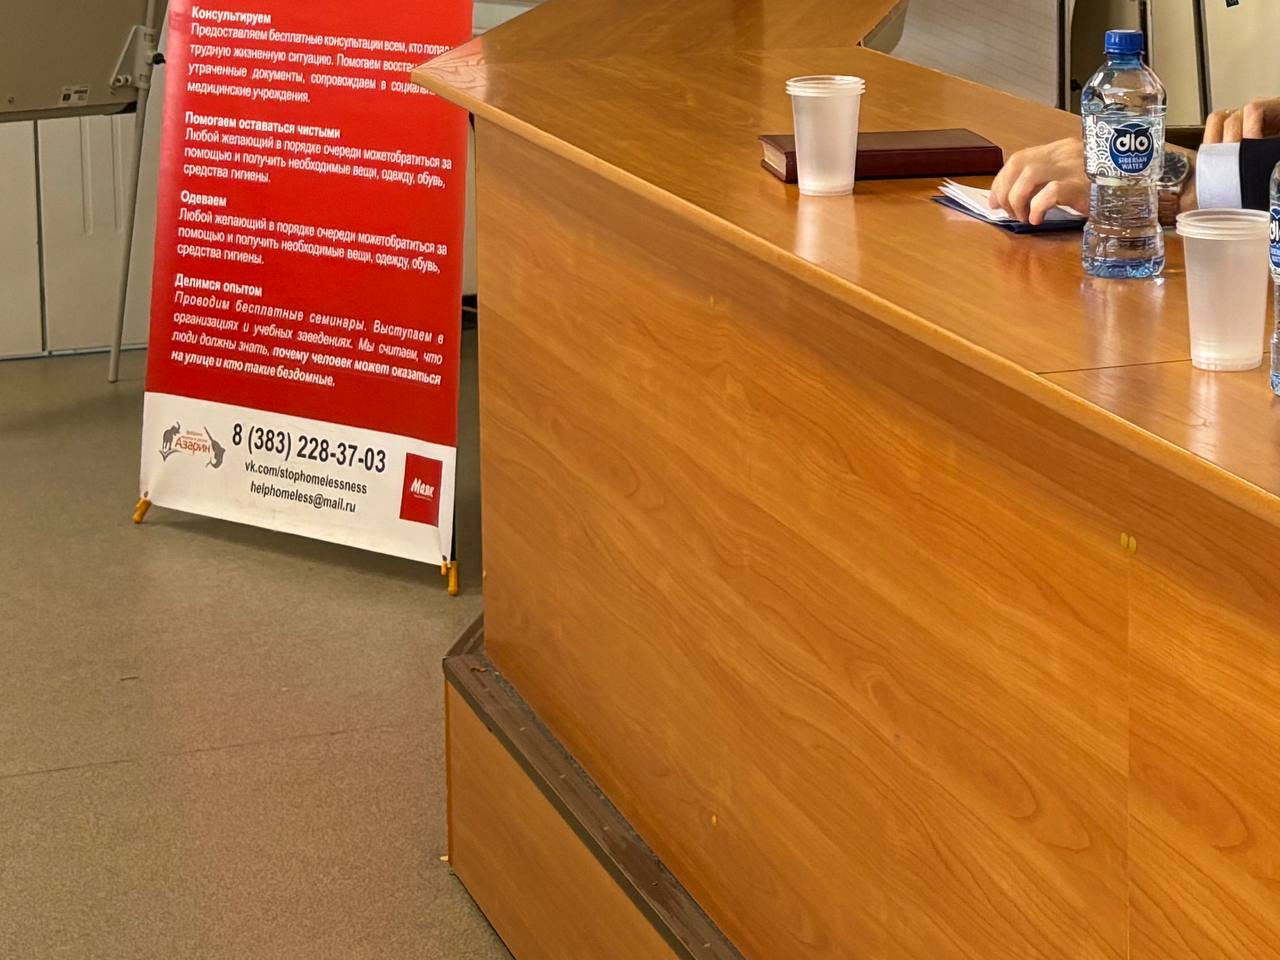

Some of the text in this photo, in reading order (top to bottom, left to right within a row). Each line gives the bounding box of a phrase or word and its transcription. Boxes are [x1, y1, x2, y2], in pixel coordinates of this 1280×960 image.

[192, 6, 271, 26] Консультируем
[191, 23, 268, 40] Предоставляем
[269, 28, 323, 45] бесплатные
[324, 36, 383, 50] консультации
[384, 41, 408, 54] всем,
[408, 43, 423, 54] кто
[190, 44, 231, 59] трудную
[233, 47, 286, 63] жизненную
[288, 51, 334, 66] ситуацию.
[337, 53, 381, 69] Помогаем
[187, 81, 311, 103] медицинские учреждения.
[188, 63, 247, 77] утраченные
[251, 68, 305, 83] документы,
[311, 73, 376, 90] сопровождаем
[381, 80, 386, 90] в
[185, 111, 341, 138] Помогаем оставаться чистыми
[184, 147, 232, 162] помощью
[234, 152, 240, 161] и
[243, 153, 286, 168] получить
[288, 157, 350, 175] необходимые
[185, 128, 219, 142] Любой
[222, 133, 274, 149] желающий
[276, 139, 282, 149] в
[284, 140, 321, 155] порядке
[323, 144, 361, 159] очереди
[441, 159, 452, 170] за
[183, 164, 271, 183] средства гигиены.
[180, 190, 227, 207] Одеваем
[178, 207, 213, 224] Любой
[214, 213, 267, 230] желающий
[269, 221, 275, 231] в
[277, 221, 315, 237] порядке
[317, 227, 356, 242] очереди
[437, 244, 448, 256] за
[178, 226, 225, 242] помощью
[227, 233, 233, 243] и
[235, 233, 279, 249] получить
[281, 239, 345, 258] необходимые
[177, 243, 265, 265] средства гигиены.
[174, 273, 263, 297] Делимся опытом
[174, 290, 444, 344] Проводим бесплатные семинары. Выступаем в
[173, 312, 239, 331] организациях
[243, 322, 250, 333] и
[253, 323, 293, 339] учебных
[358, 337, 375, 352] Мы
[423, 352, 443, 365] что
[171, 331, 198, 344] люди
[200, 332, 237, 349] должны
[272, 346, 310, 364] почему
[311, 353, 352, 368] человек
[354, 360, 390, 375] может
[391, 366, 442, 385] оказаться
[171, 350, 336, 387] на улице и кто такие бездомные.
[232, 423, 386, 473] 8 (383) 228-37-03
[244, 460, 368, 494] vk.com/stophomelessness
[250, 480, 356, 513] helphomeless@mail.ru
